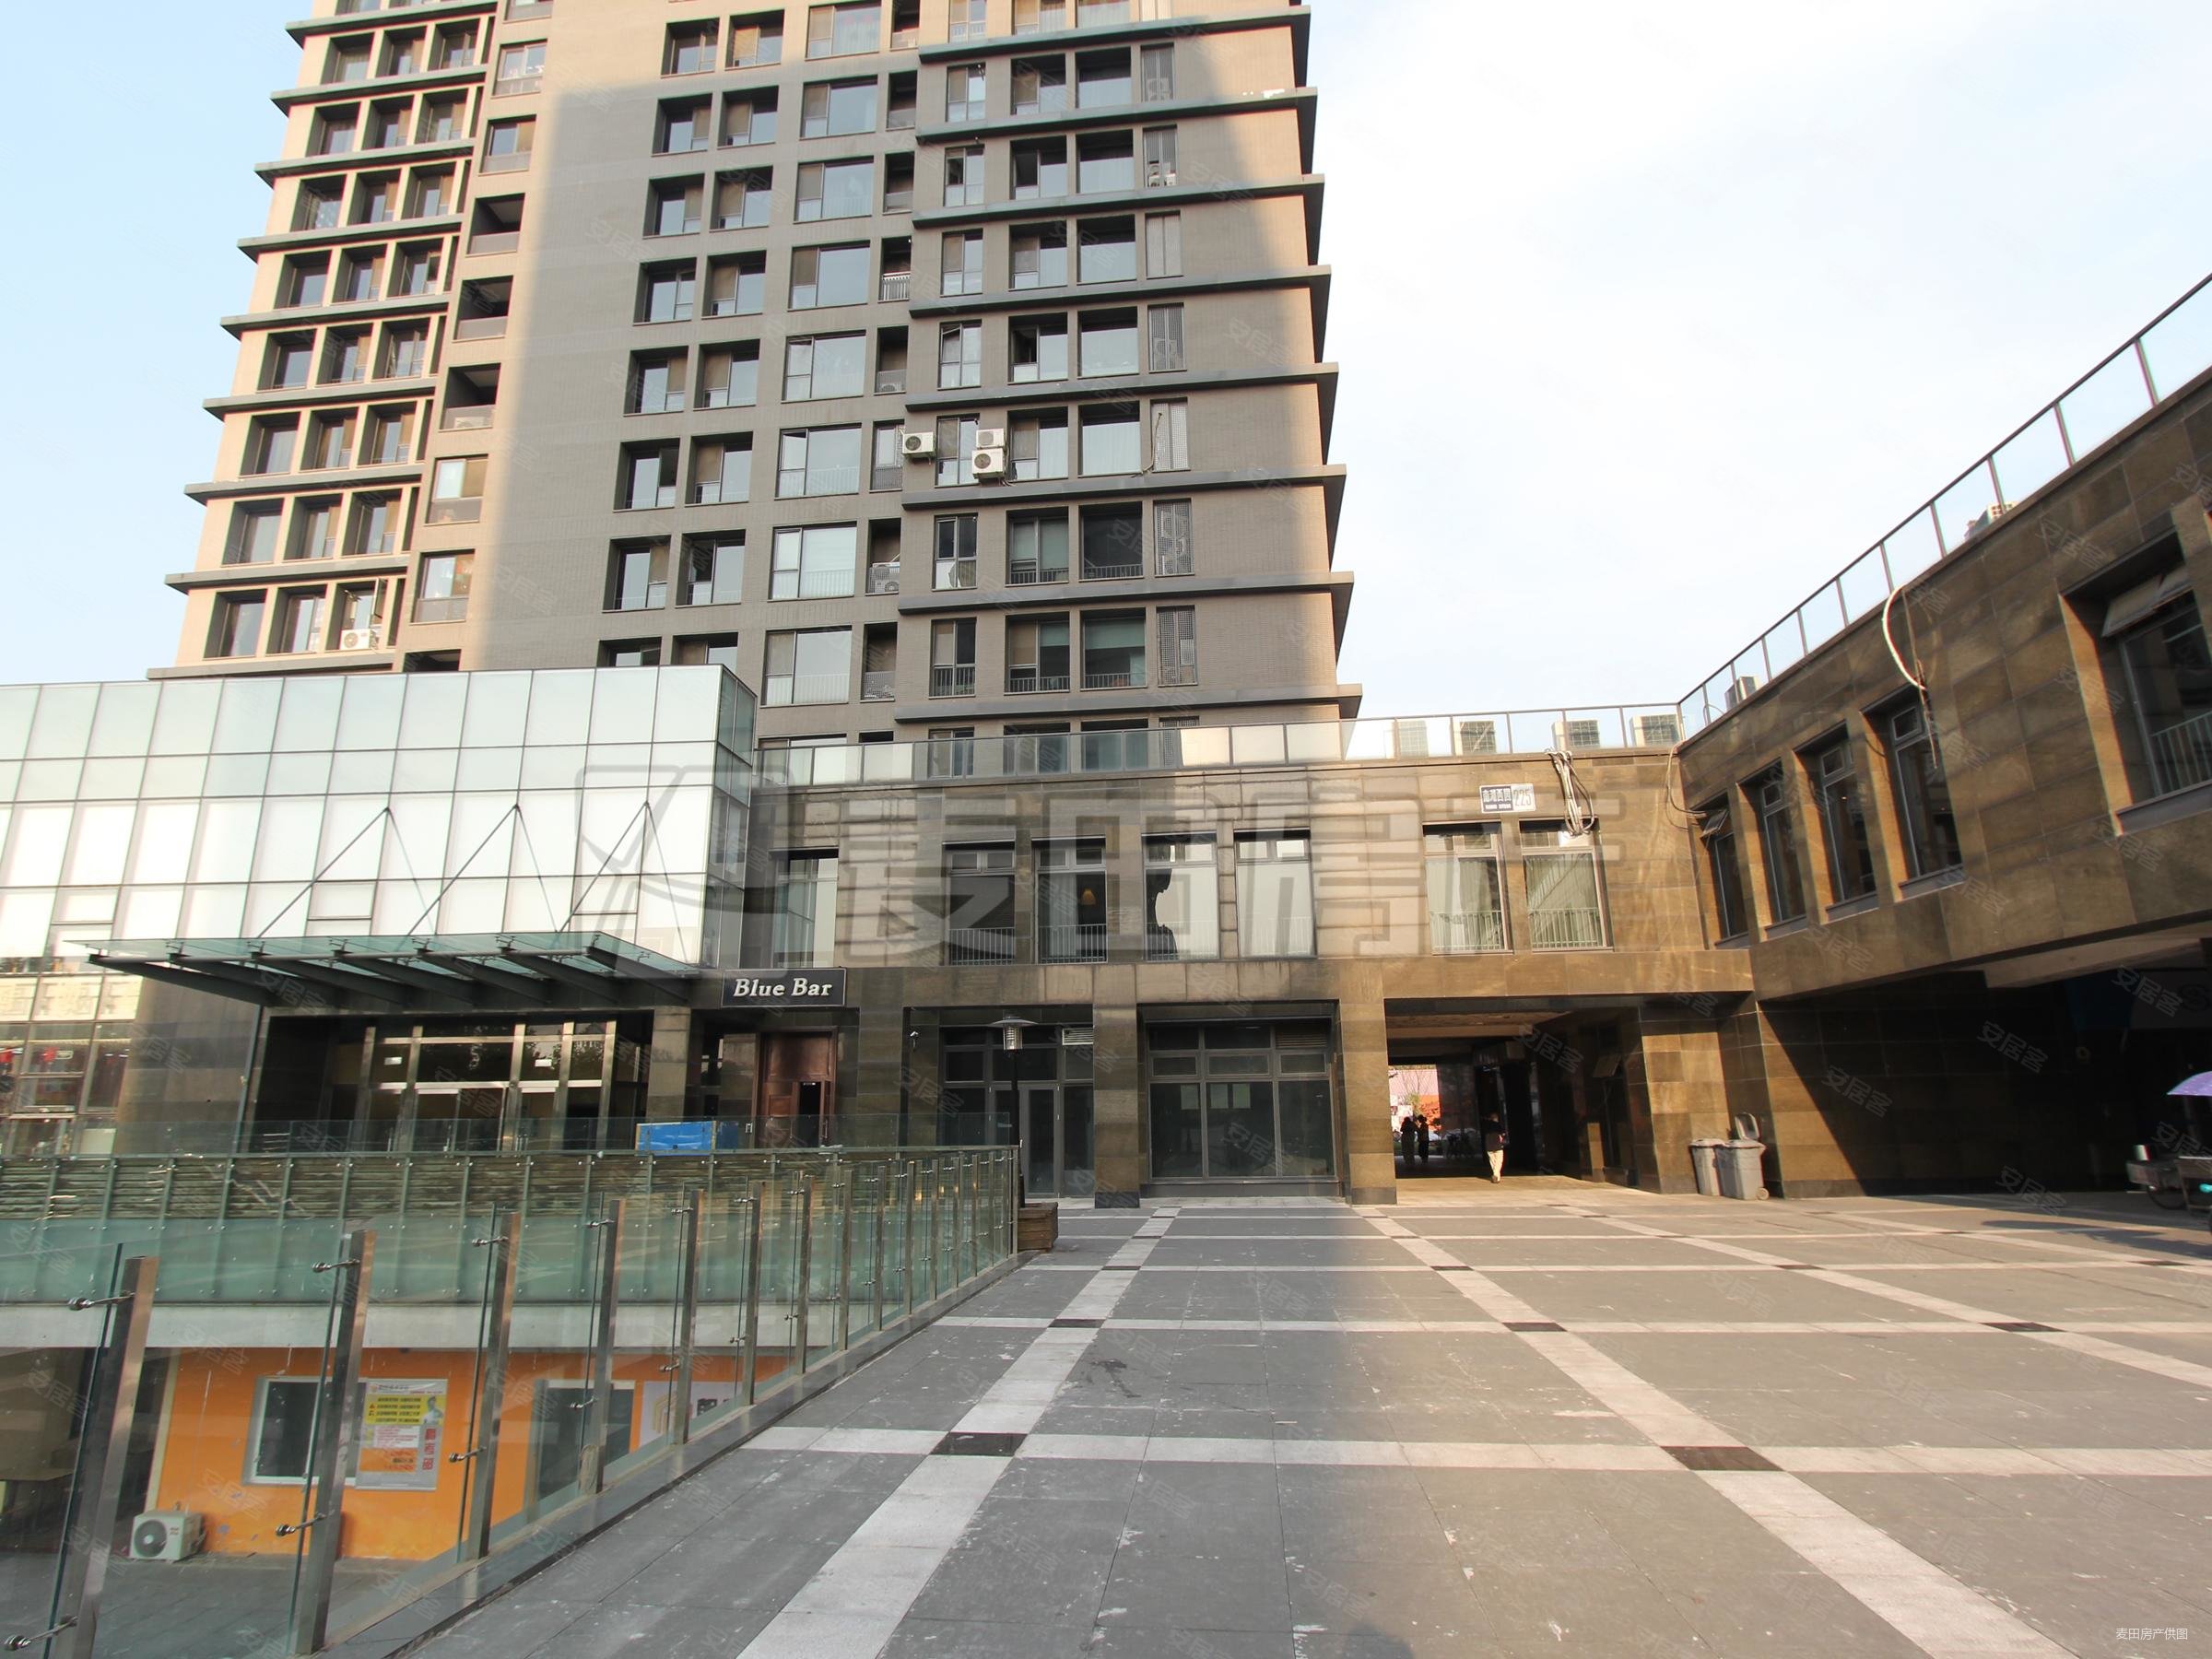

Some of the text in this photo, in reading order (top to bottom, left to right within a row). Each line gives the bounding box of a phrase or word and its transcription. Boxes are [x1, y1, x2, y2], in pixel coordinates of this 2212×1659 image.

[1513, 789, 1532, 806] 225
[733, 977, 832, 998] Blue Bar
